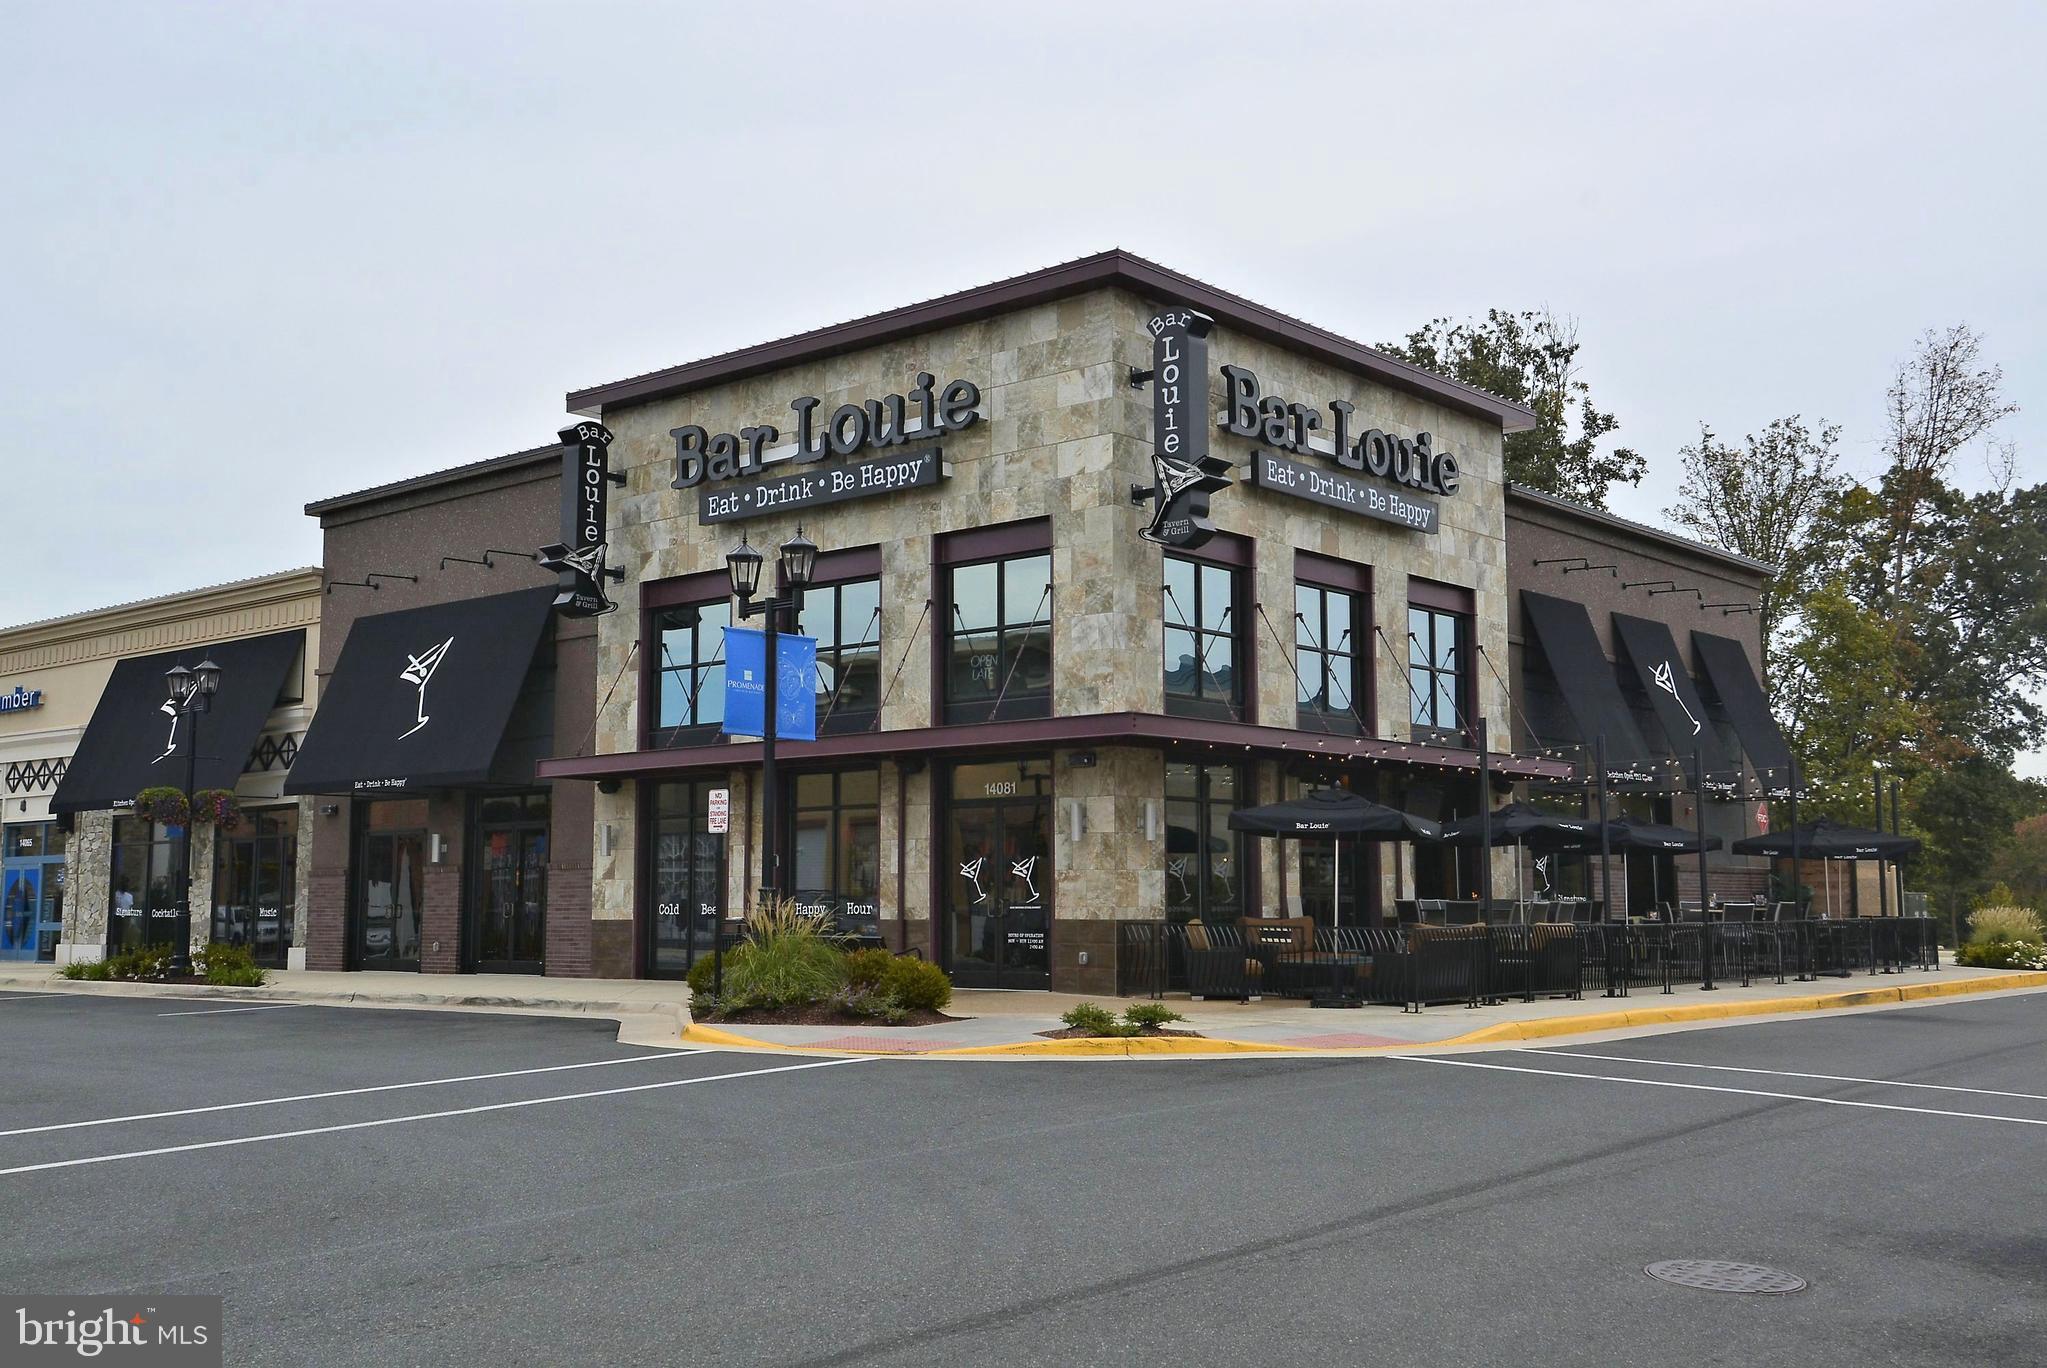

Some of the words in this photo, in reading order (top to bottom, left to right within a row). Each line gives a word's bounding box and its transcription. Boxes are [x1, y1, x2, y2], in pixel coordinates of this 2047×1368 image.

[1150, 311, 1191, 336] Bar
[1162, 336, 1180, 454] Louie
[577, 425, 613, 445] Bar
[669, 424, 779, 489] Bar
[790, 371, 981, 465] Louie
[1220, 364, 1323, 456] Bar
[1328, 399, 1461, 497] Louie
[585, 445, 600, 542] Louie
[708, 496, 740, 517] Eat
[756, 479, 814, 509] Drink
[831, 470, 855, 494] Be
[1267, 459, 1295, 487] Eat
[1309, 471, 1356, 504] Drink
[1369, 488, 1386, 512] Be
[1389, 494, 1432, 528] Happy
[1163, 520, 1189, 528] Tavern
[1171, 526, 1189, 535] Grill
[984, 781, 1016, 795] 14081
[259, 907, 278, 917] Music
[658, 903, 680, 915] Cold
[795, 902, 827, 917] Happy
[846, 902, 873, 915] Hour
